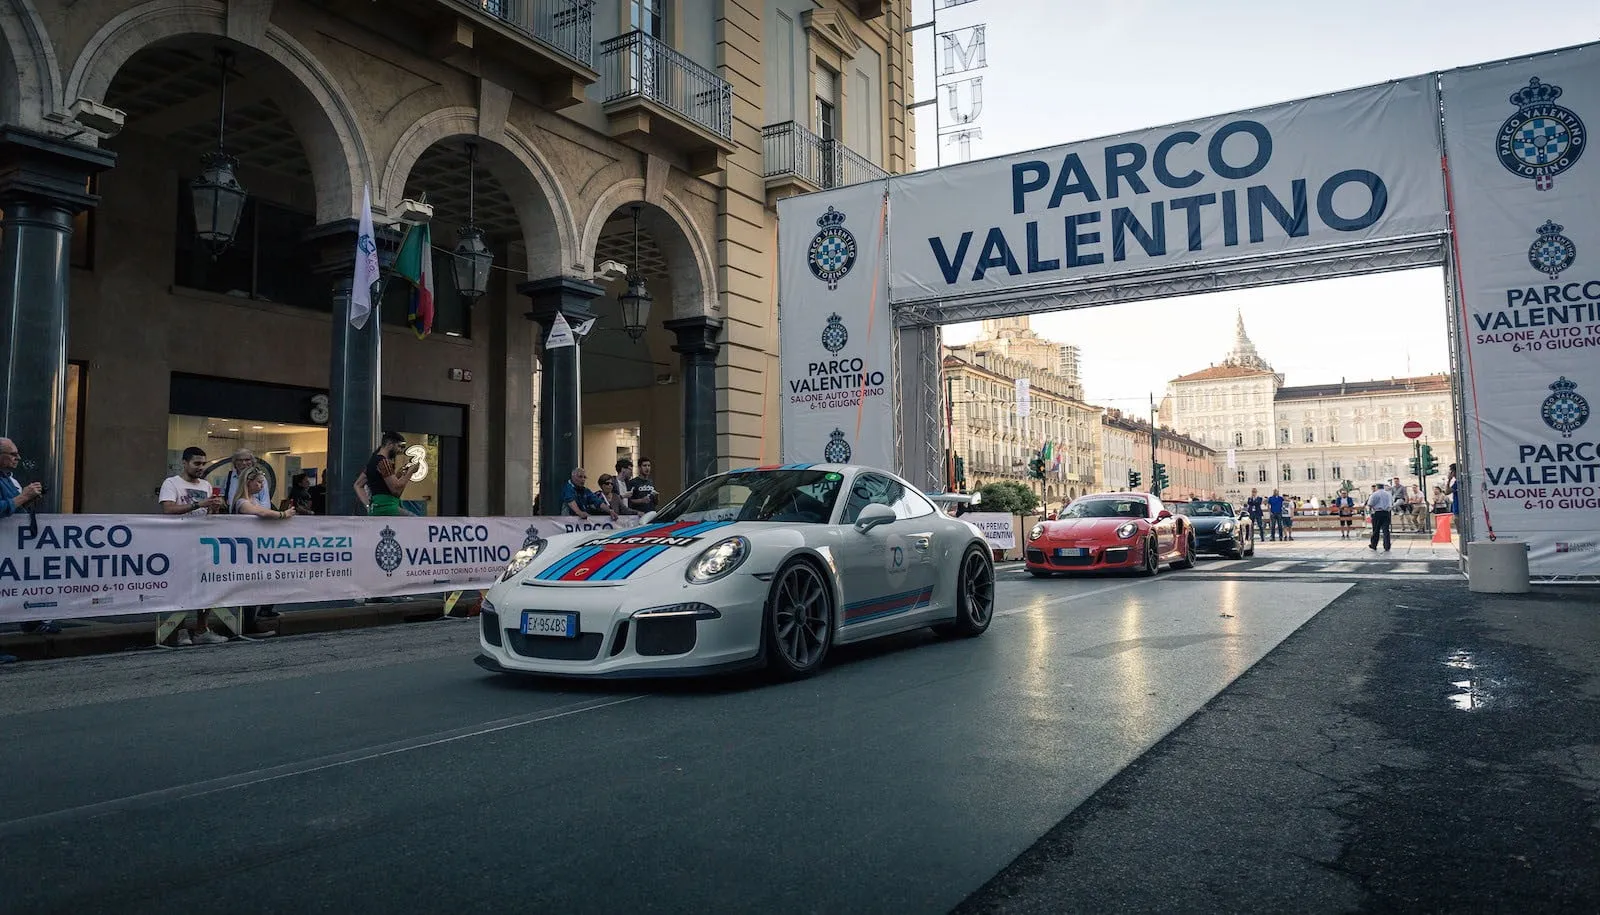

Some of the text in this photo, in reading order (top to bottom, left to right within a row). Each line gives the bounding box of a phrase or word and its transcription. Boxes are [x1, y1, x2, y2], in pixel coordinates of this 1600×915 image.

[1501, 107, 1582, 156] PARCO VALENTINO
[1011, 120, 1273, 215] PARCO
[1516, 158, 1569, 175] TORINO
[928, 168, 1388, 286] VALENTINO
[1507, 281, 1600, 307] PARCO
[1473, 302, 1600, 331] VALENTI
[1477, 330, 1535, 345] SALONE
[1540, 327, 1581, 339] AUTO
[1512, 342, 1542, 353] 6-10
[809, 358, 863, 376] PARCO
[790, 371, 884, 393] VALENTINO
[791, 388, 884, 404] SALONE AUTO TORINO
[310, 394, 329, 423] 3
[810, 401, 826, 410] 6-10
[1520, 442, 1600, 463] PARC
[405, 444, 429, 482] 3
[1485, 464, 1600, 486] VALENT
[1488, 487, 1595, 499] SALONE AUTO
[1524, 498, 1600, 510] 6-10 GIUG
[428, 524, 488, 543] PARCO
[986, 522, 1010, 530] PREMIO
[17, 524, 133, 550] PARCO
[257, 536, 353, 549] MARAZZI
[583, 537, 693, 546] MARTINI
[257, 551, 353, 564] NOLEGGIO
[405, 545, 511, 566] VALENTINO
[0, 552, 170, 581] ALENTINO
[200, 567, 352, 583] Allestimenti e Servizi per Eventi
[406, 569, 432, 577] SALONE
[432, 567, 449, 576] AUTO
[450, 567, 474, 575] TORINO
[487, 565, 509, 573] GIUGN
[22, 586, 54, 596] AUTO
[57, 584, 99, 594] TORINO
[102, 583, 125, 592] 6-10
[127, 581, 169, 590] GIUGNO
